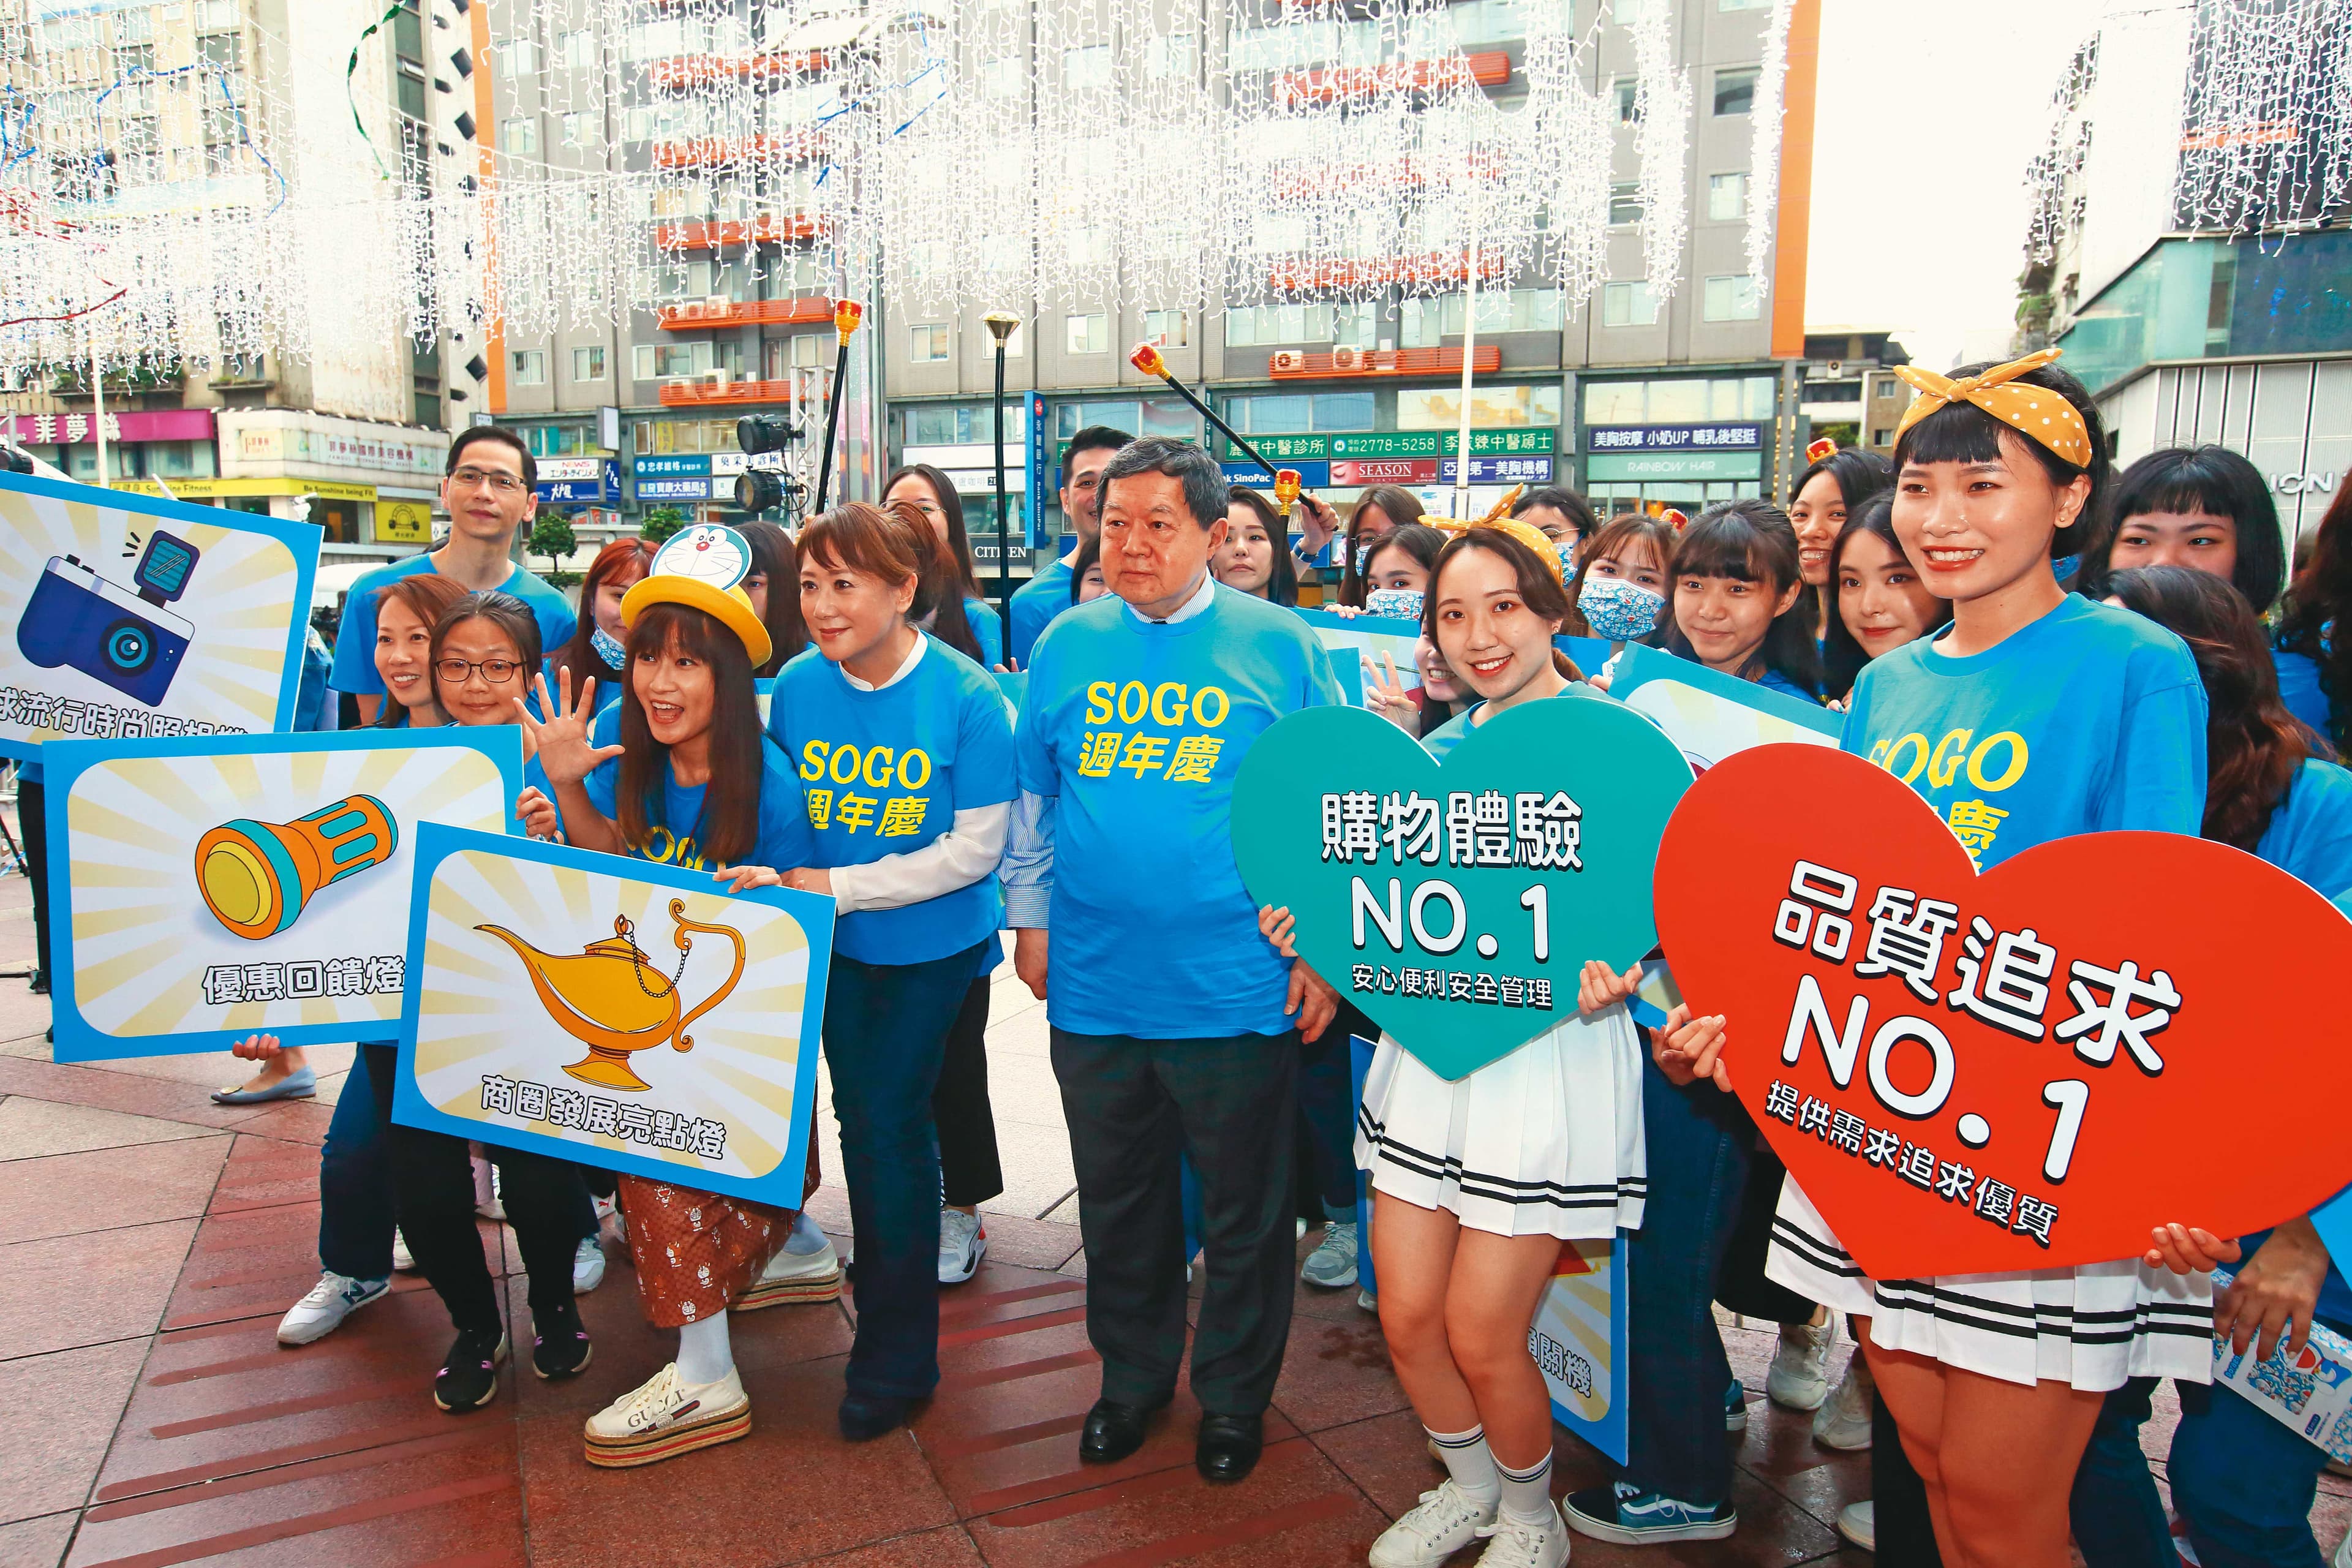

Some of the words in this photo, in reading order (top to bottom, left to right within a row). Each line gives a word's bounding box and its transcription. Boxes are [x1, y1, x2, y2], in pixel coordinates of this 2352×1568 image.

[34, 412, 121, 443] 菲夢絲
[1360, 437, 1435, 452] 2778-5258
[1594, 431, 1644, 447] 美胸按摩
[1647, 430, 1688, 446] 小奶UP
[146, 484, 182, 494] Sunine
[184, 484, 213, 492] Fitness
[1234, 473, 1270, 483] SinoPac
[1359, 464, 1412, 476] SEASON
[1444, 460, 1549, 476] 亞第一美胸機構
[1627, 461, 1686, 473] RAINBOW
[1689, 461, 1716, 471] HAIR
[974, 546, 1027, 558] CITIEN
[1085, 680, 1230, 728] SOGO
[800, 739, 932, 790] SOGO
[1077, 731, 1226, 783] 週年慶
[804, 790, 930, 838] 週年慶
[1321, 789, 1583, 873] 購物體驗
[202, 955, 405, 1005] 優惠回饋燈
[1351, 963, 1553, 1011] 安心便利安全管理
[1772, 859, 2183, 1077] 品質追求
[481, 1074, 726, 1160] 商圈發展亮點燈
[1765, 1079, 2057, 1249] 提供需求追求優質
